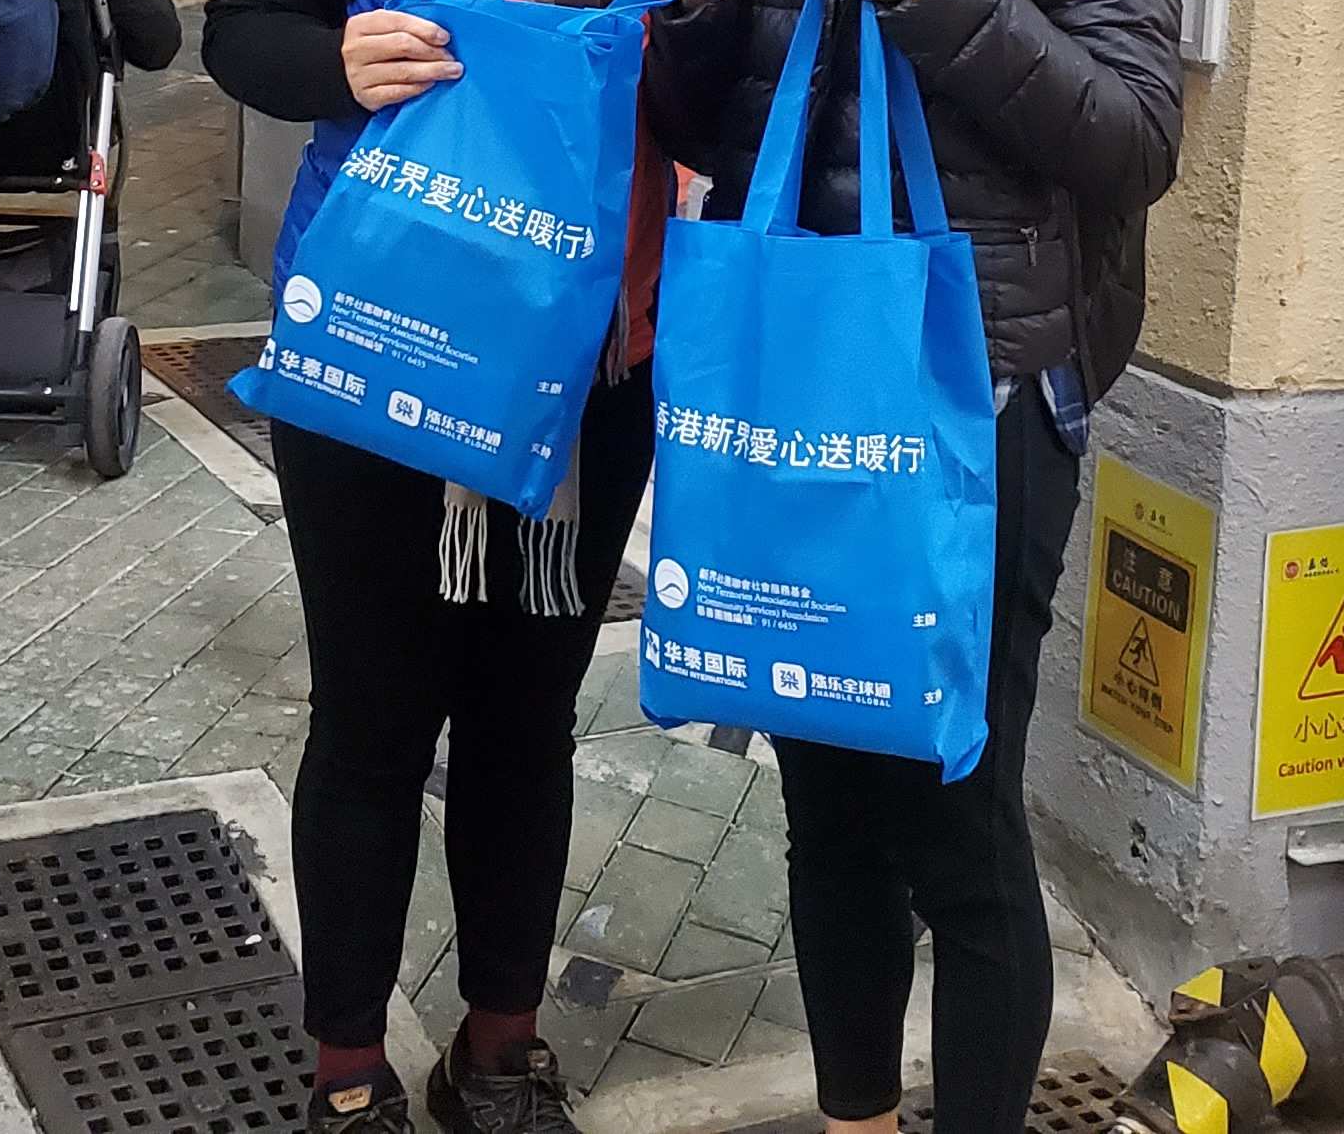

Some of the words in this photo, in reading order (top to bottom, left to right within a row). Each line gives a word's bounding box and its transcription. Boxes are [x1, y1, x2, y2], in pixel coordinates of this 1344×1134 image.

[279, 348, 367, 397] 华泰国际
[1111, 569, 1181, 622] CAUTION
[664, 640, 747, 679] 华泰国际
[1278, 754, 1333, 779] Caution
